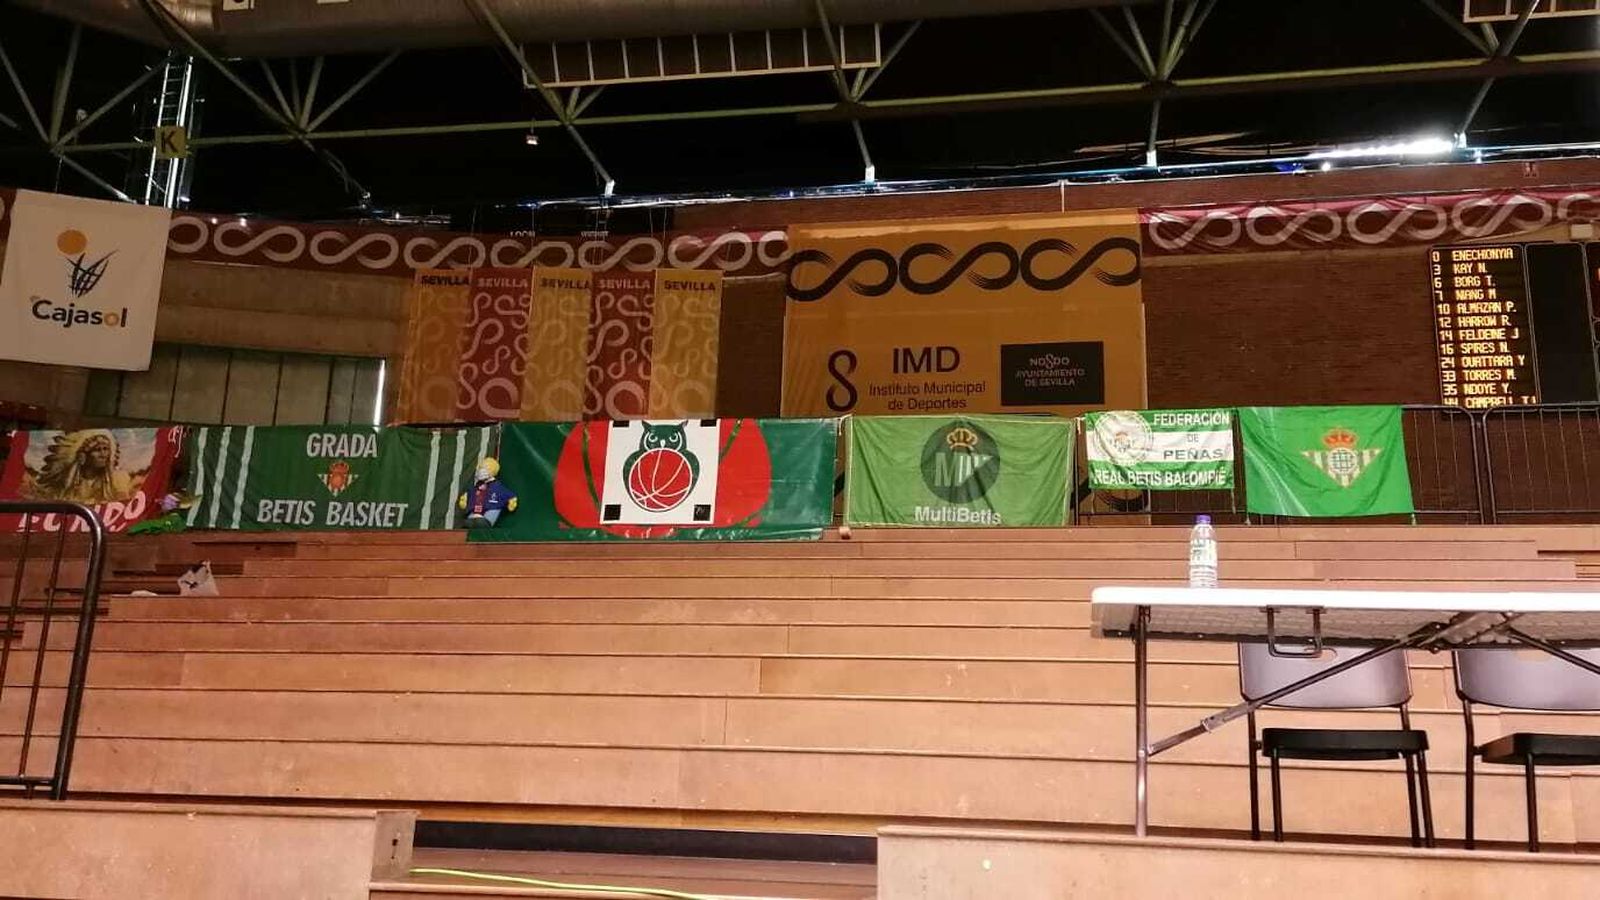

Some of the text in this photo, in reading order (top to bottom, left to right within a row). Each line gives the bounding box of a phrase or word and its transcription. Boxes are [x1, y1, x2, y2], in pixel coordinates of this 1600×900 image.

[161, 131, 178, 153] K
[1433, 264, 1441, 275] 3
[1453, 262, 1473, 274] KAY
[421, 275, 469, 286] SEVILLA
[478, 277, 528, 288] SEVILLA
[540, 277, 590, 289] SEVILLA
[600, 279, 651, 289] SEVILLA
[664, 279, 716, 291] SEVILLA
[1435, 274, 1496, 288] 6 BORG T.
[1435, 290, 1443, 301] 7
[1455, 289, 1485, 300] NIANG
[32, 299, 128, 328] Cajasol
[1437, 300, 1517, 315] 10 ALMAZAN P.
[1438, 316, 1452, 328] 12
[1457, 315, 1497, 327] HARROW
[1439, 330, 1453, 341] 14
[1440, 343, 1454, 355] 16
[1460, 341, 1496, 354] SPIRES
[892, 346, 961, 374] IMD
[1441, 356, 1455, 368] 24
[1461, 354, 1514, 368] OUATTARA
[1015, 367, 1086, 379] AYUNTAMIENTO
[1441, 370, 1456, 382] 33
[1462, 368, 1502, 381] TORRES
[869, 380, 986, 397] Instituto Municipal
[1024, 378, 1076, 388] DE SEVILLA
[1442, 383, 1458, 396] 35
[1463, 383, 1497, 395] NDOYE
[888, 398, 967, 411] de Deportes
[306, 432, 378, 458] GRADA
[1187, 434, 1199, 443] DE
[1164, 446, 1223, 460] PEÑAS
[1094, 470, 1126, 485] REAL
[1128, 470, 1162, 485] BETIS
[257, 499, 409, 527] BETIS BASKET
[914, 505, 1002, 525] MultiBetis
